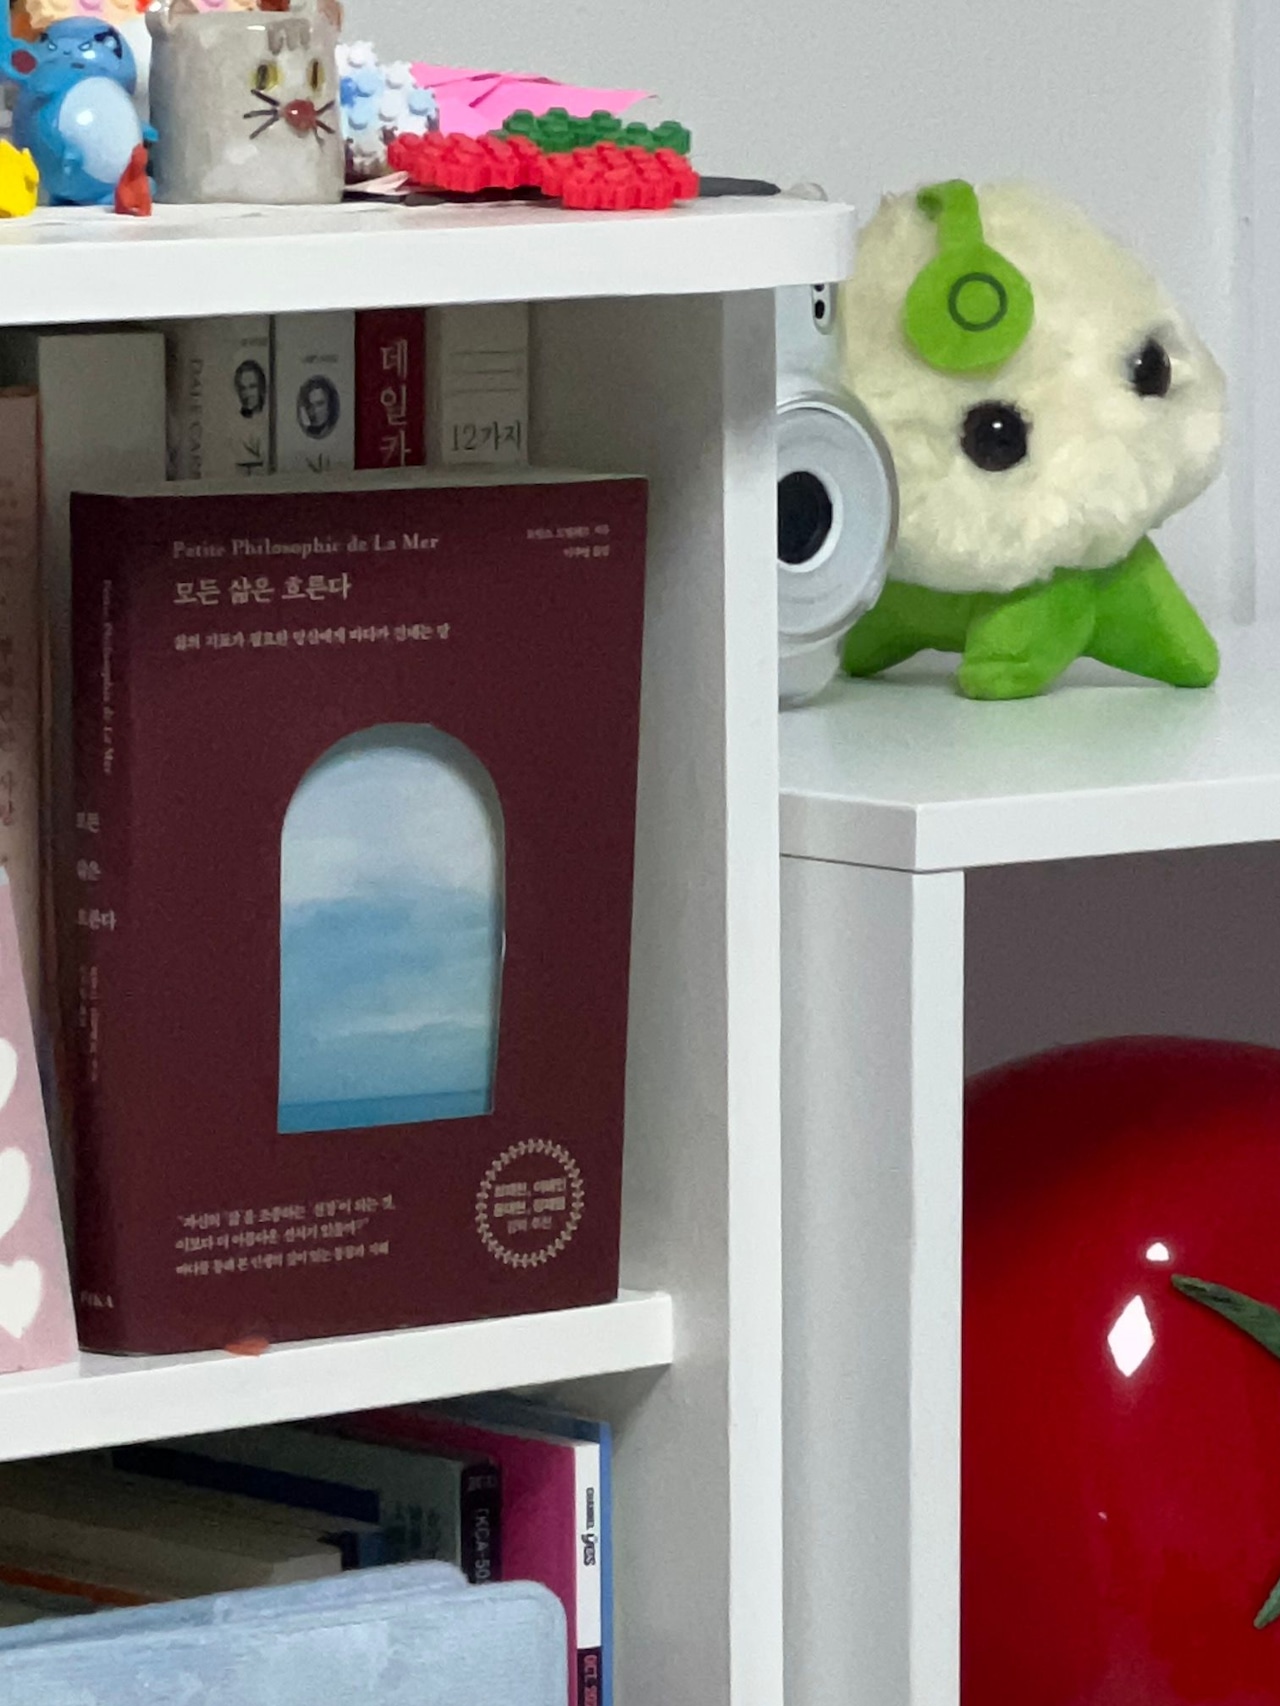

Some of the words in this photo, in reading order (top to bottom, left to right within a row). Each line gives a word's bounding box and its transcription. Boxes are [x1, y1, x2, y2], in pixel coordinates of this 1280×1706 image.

[379, 338, 411, 467] 데일카
[452, 420, 521, 451] 12가지
[173, 540, 226, 559] Petite
[232, 536, 340, 559] Philosophie
[347, 534, 368, 553] de
[374, 533, 397, 551] La
[403, 531, 439, 550] Mer
[173, 578, 222, 605] 모든
[228, 576, 275, 604] 삶은
[281, 572, 351, 600] 흐른다
